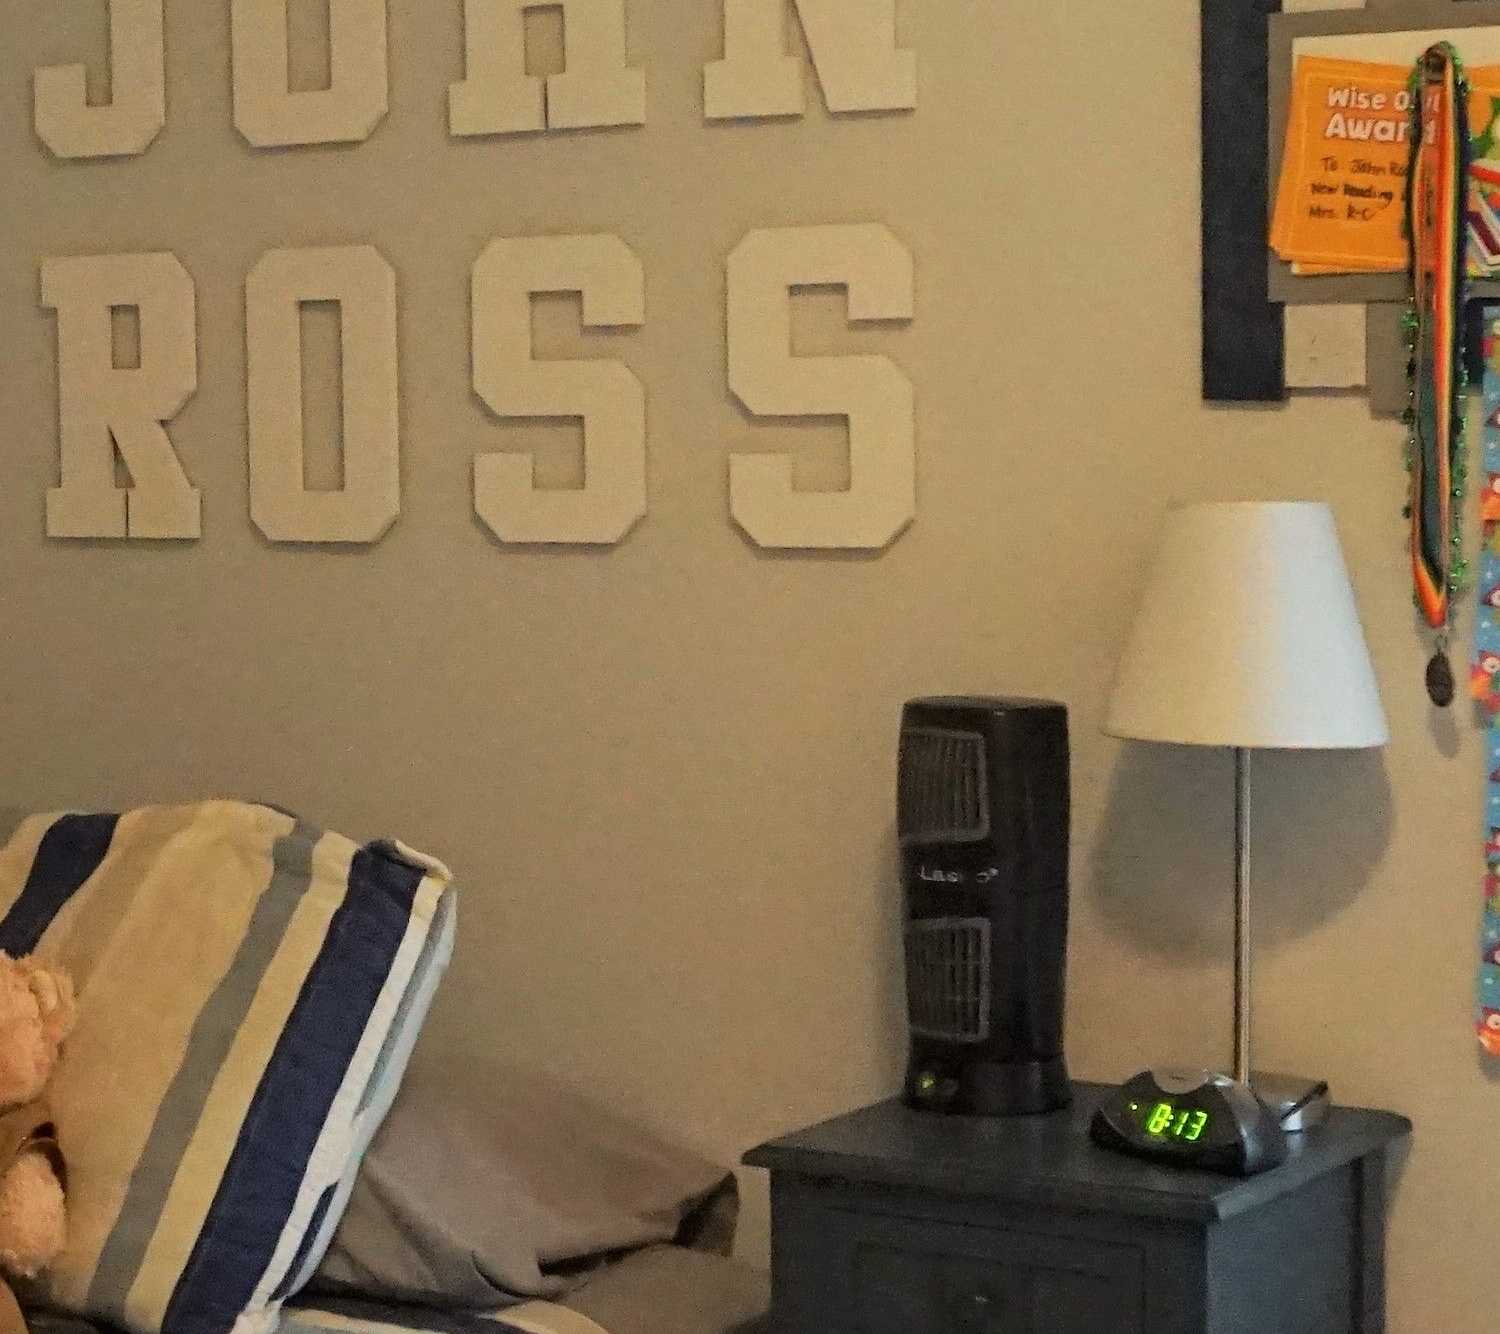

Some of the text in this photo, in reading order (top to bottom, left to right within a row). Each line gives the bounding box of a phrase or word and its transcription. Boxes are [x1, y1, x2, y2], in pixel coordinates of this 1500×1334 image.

[1327, 86, 1387, 110] Wise
[40, 221, 916, 549] ROSS
[1148, 1103, 1208, 1141] 8:13
